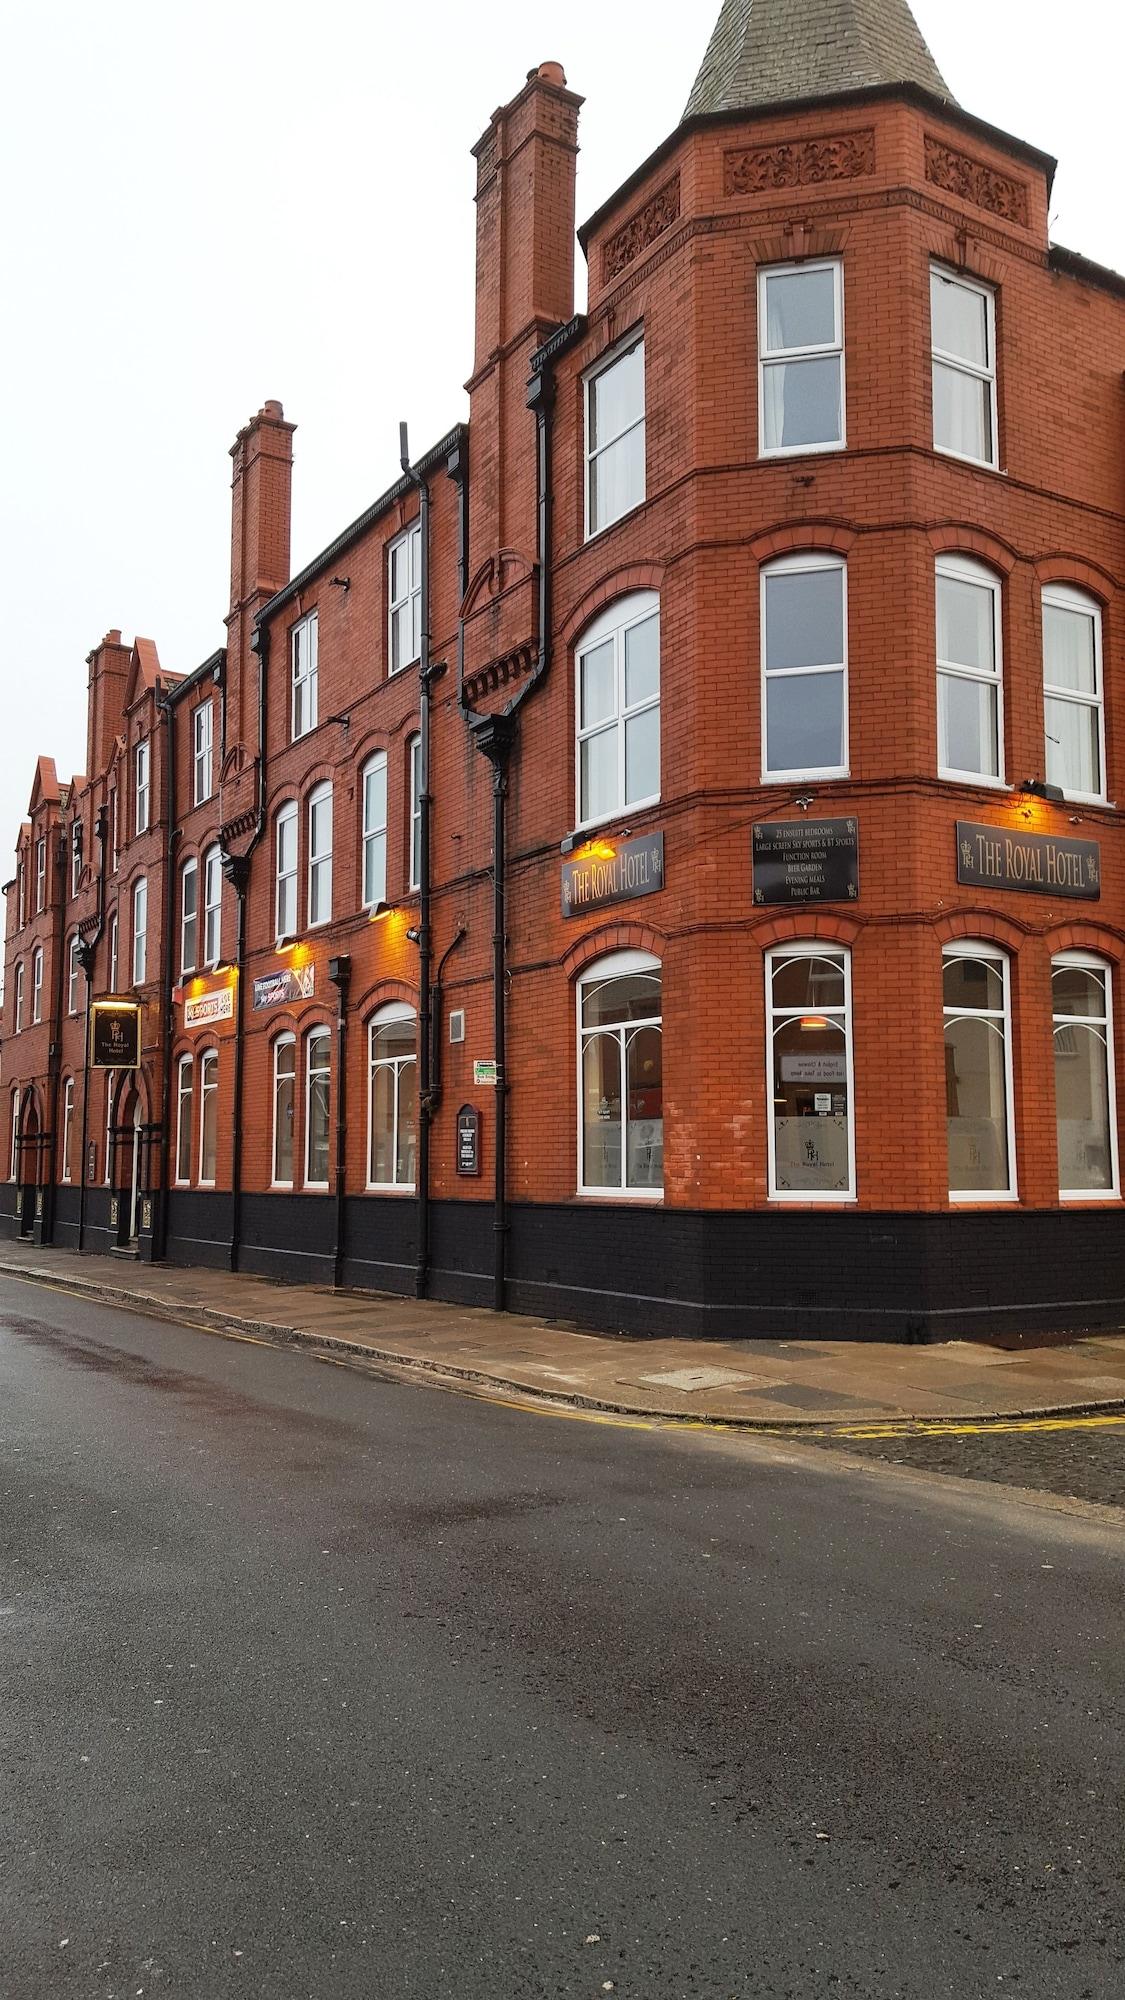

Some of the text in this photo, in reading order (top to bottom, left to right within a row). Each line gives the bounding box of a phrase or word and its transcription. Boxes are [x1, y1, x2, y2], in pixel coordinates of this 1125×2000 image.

[783, 829, 804, 838] ENSUITE
[804, 827, 833, 837] BEDROOMS
[755, 842, 772, 852] LARGE
[772, 841, 792, 850] SCREEN
[802, 839, 821, 849] SPORTS
[821, 839, 827, 847] &
[827, 838, 834, 847] BT
[835, 837, 855, 847] SPORTS
[783, 851, 827, 861] FUNCTION ROOM
[975, 833, 1086, 888] THE ROYAL HOTEL
[787, 862, 823, 873] BEER GARDEN
[572, 851, 650, 905] THE ROYAL HOTEL
[785, 874, 825, 885] EVENING MEALS
[790, 886, 821, 897] PUBLIC BAR
